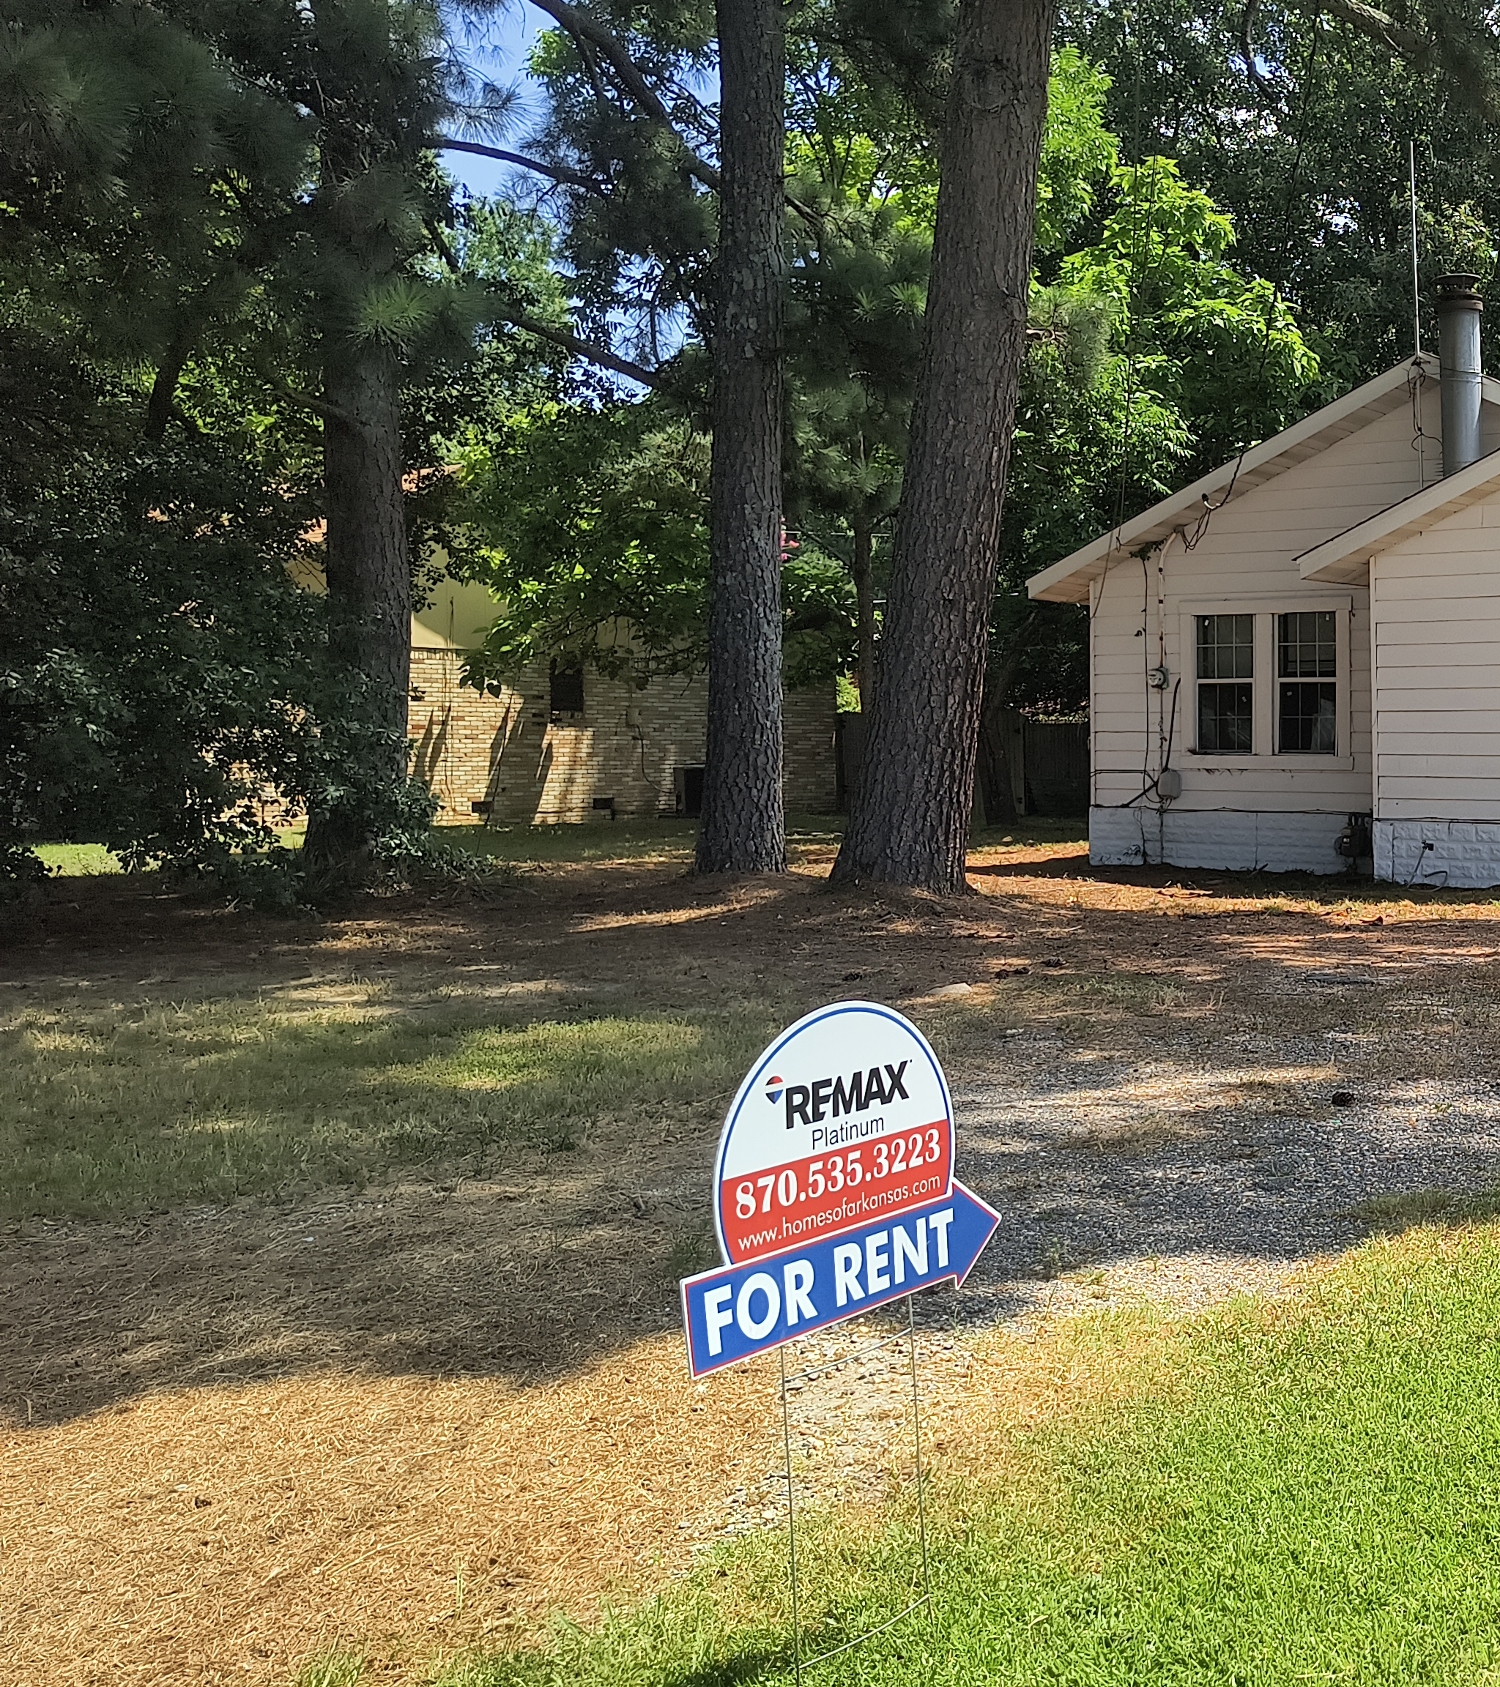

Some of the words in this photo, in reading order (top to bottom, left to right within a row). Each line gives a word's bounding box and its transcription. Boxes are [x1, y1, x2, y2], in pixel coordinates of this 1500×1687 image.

[735, 1128, 941, 1219] 870.535.3223
[812, 1117, 884, 1150] Platinum
[738, 1175, 941, 1251] www.homesofarkansas.com
[704, 1259, 818, 1357] FOR
[833, 1208, 954, 1307] RENT
